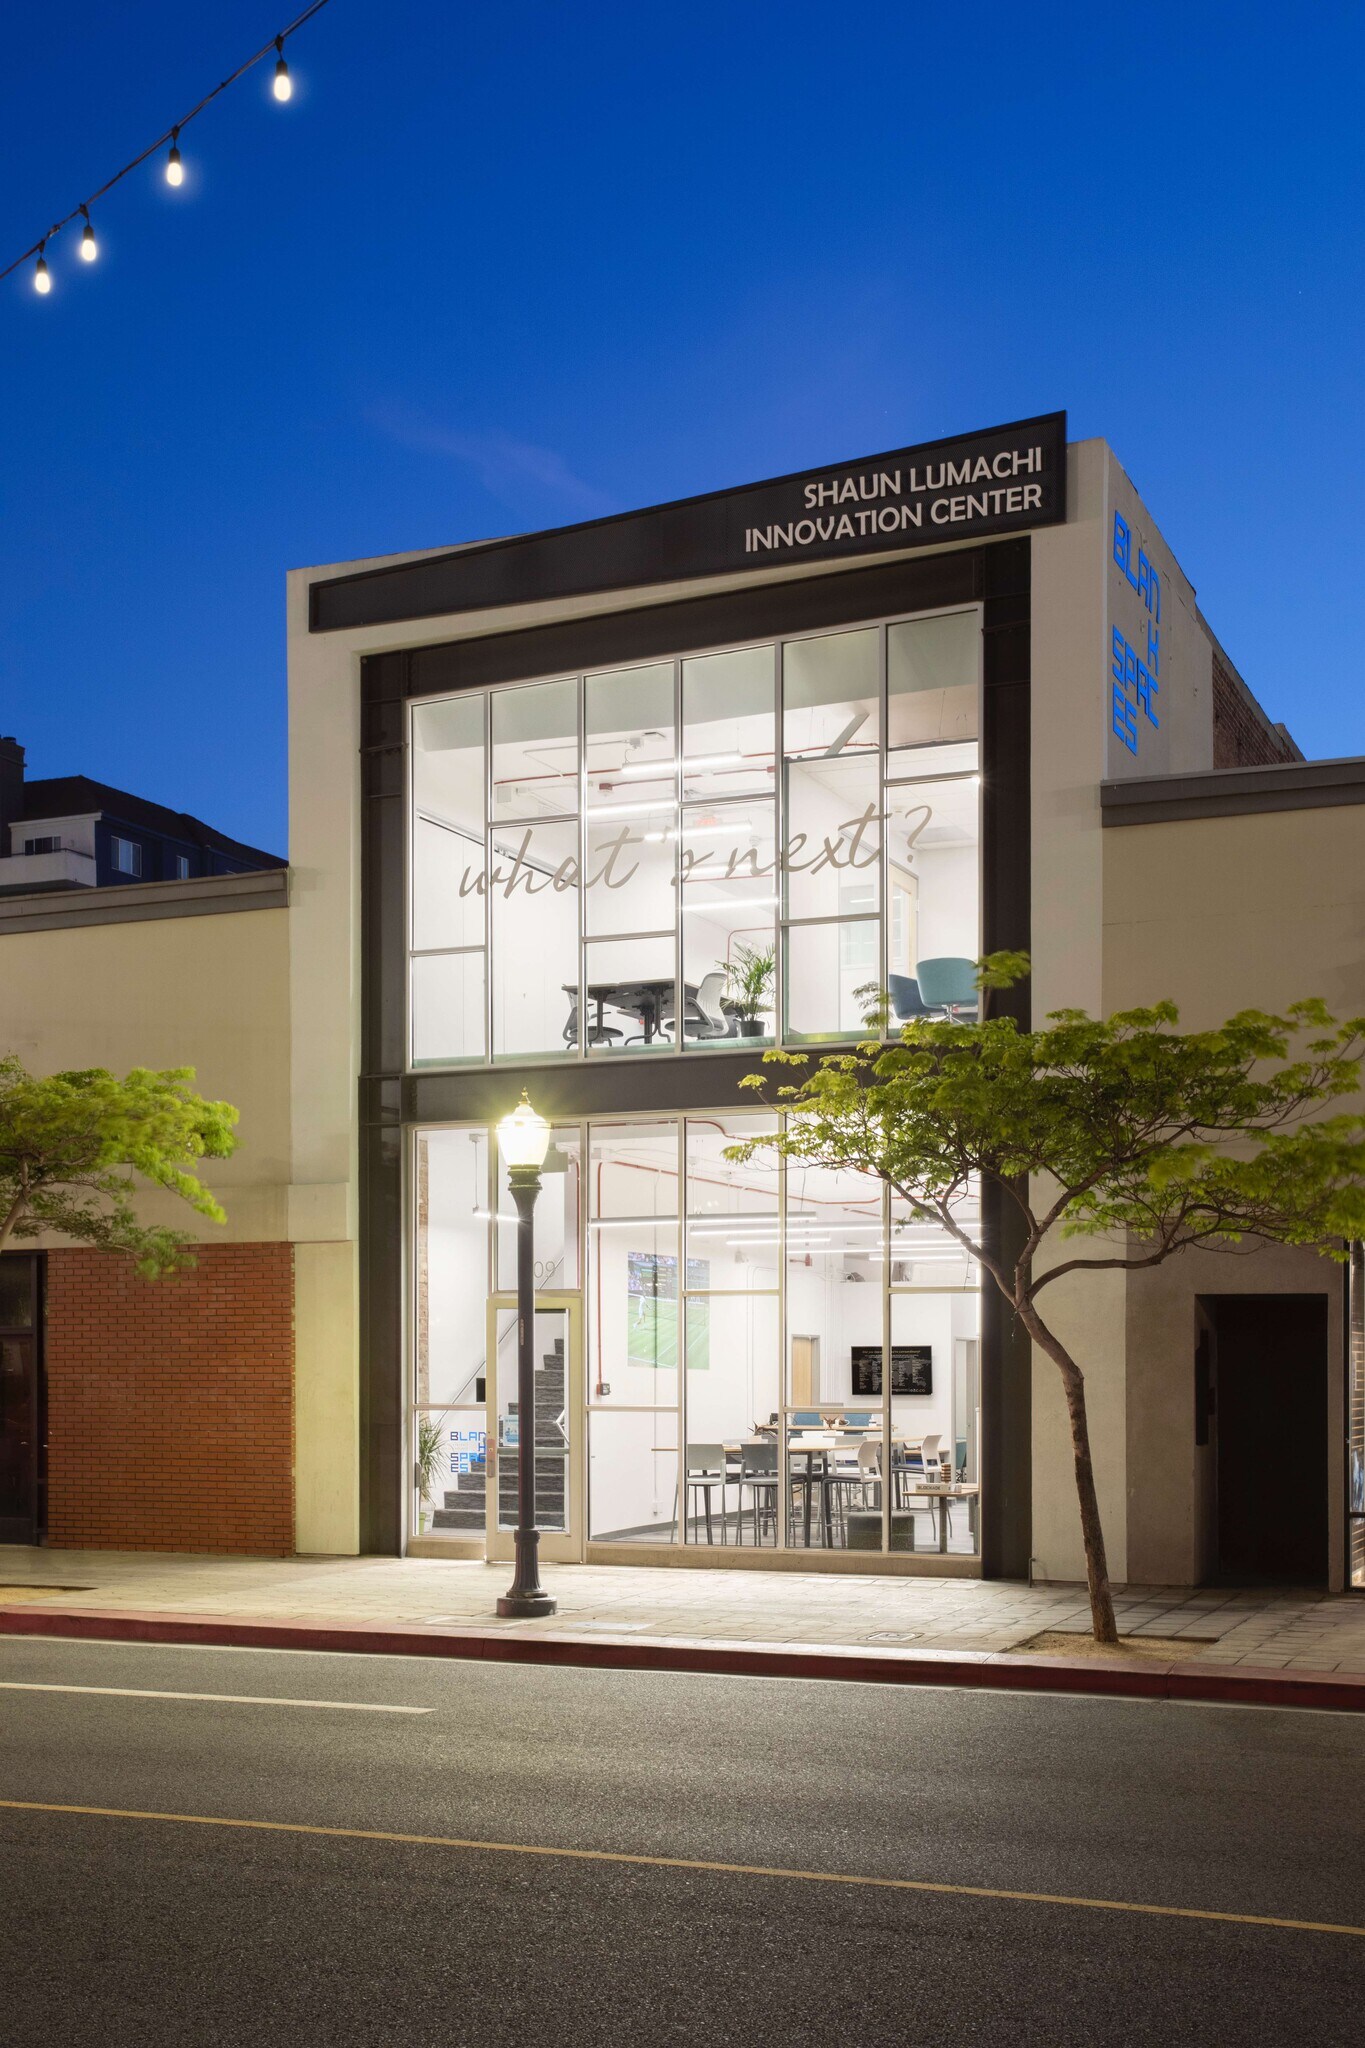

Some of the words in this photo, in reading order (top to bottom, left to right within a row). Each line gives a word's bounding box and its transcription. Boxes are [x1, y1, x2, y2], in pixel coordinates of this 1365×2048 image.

[804, 470, 901, 509] SHAUN
[910, 447, 1042, 492] LUMACHI
[745, 502, 922, 552] INNOVATION
[931, 484, 1042, 524] CENTER
[1112, 682, 1138, 757] ES
[450, 1463, 468, 1473] ES
